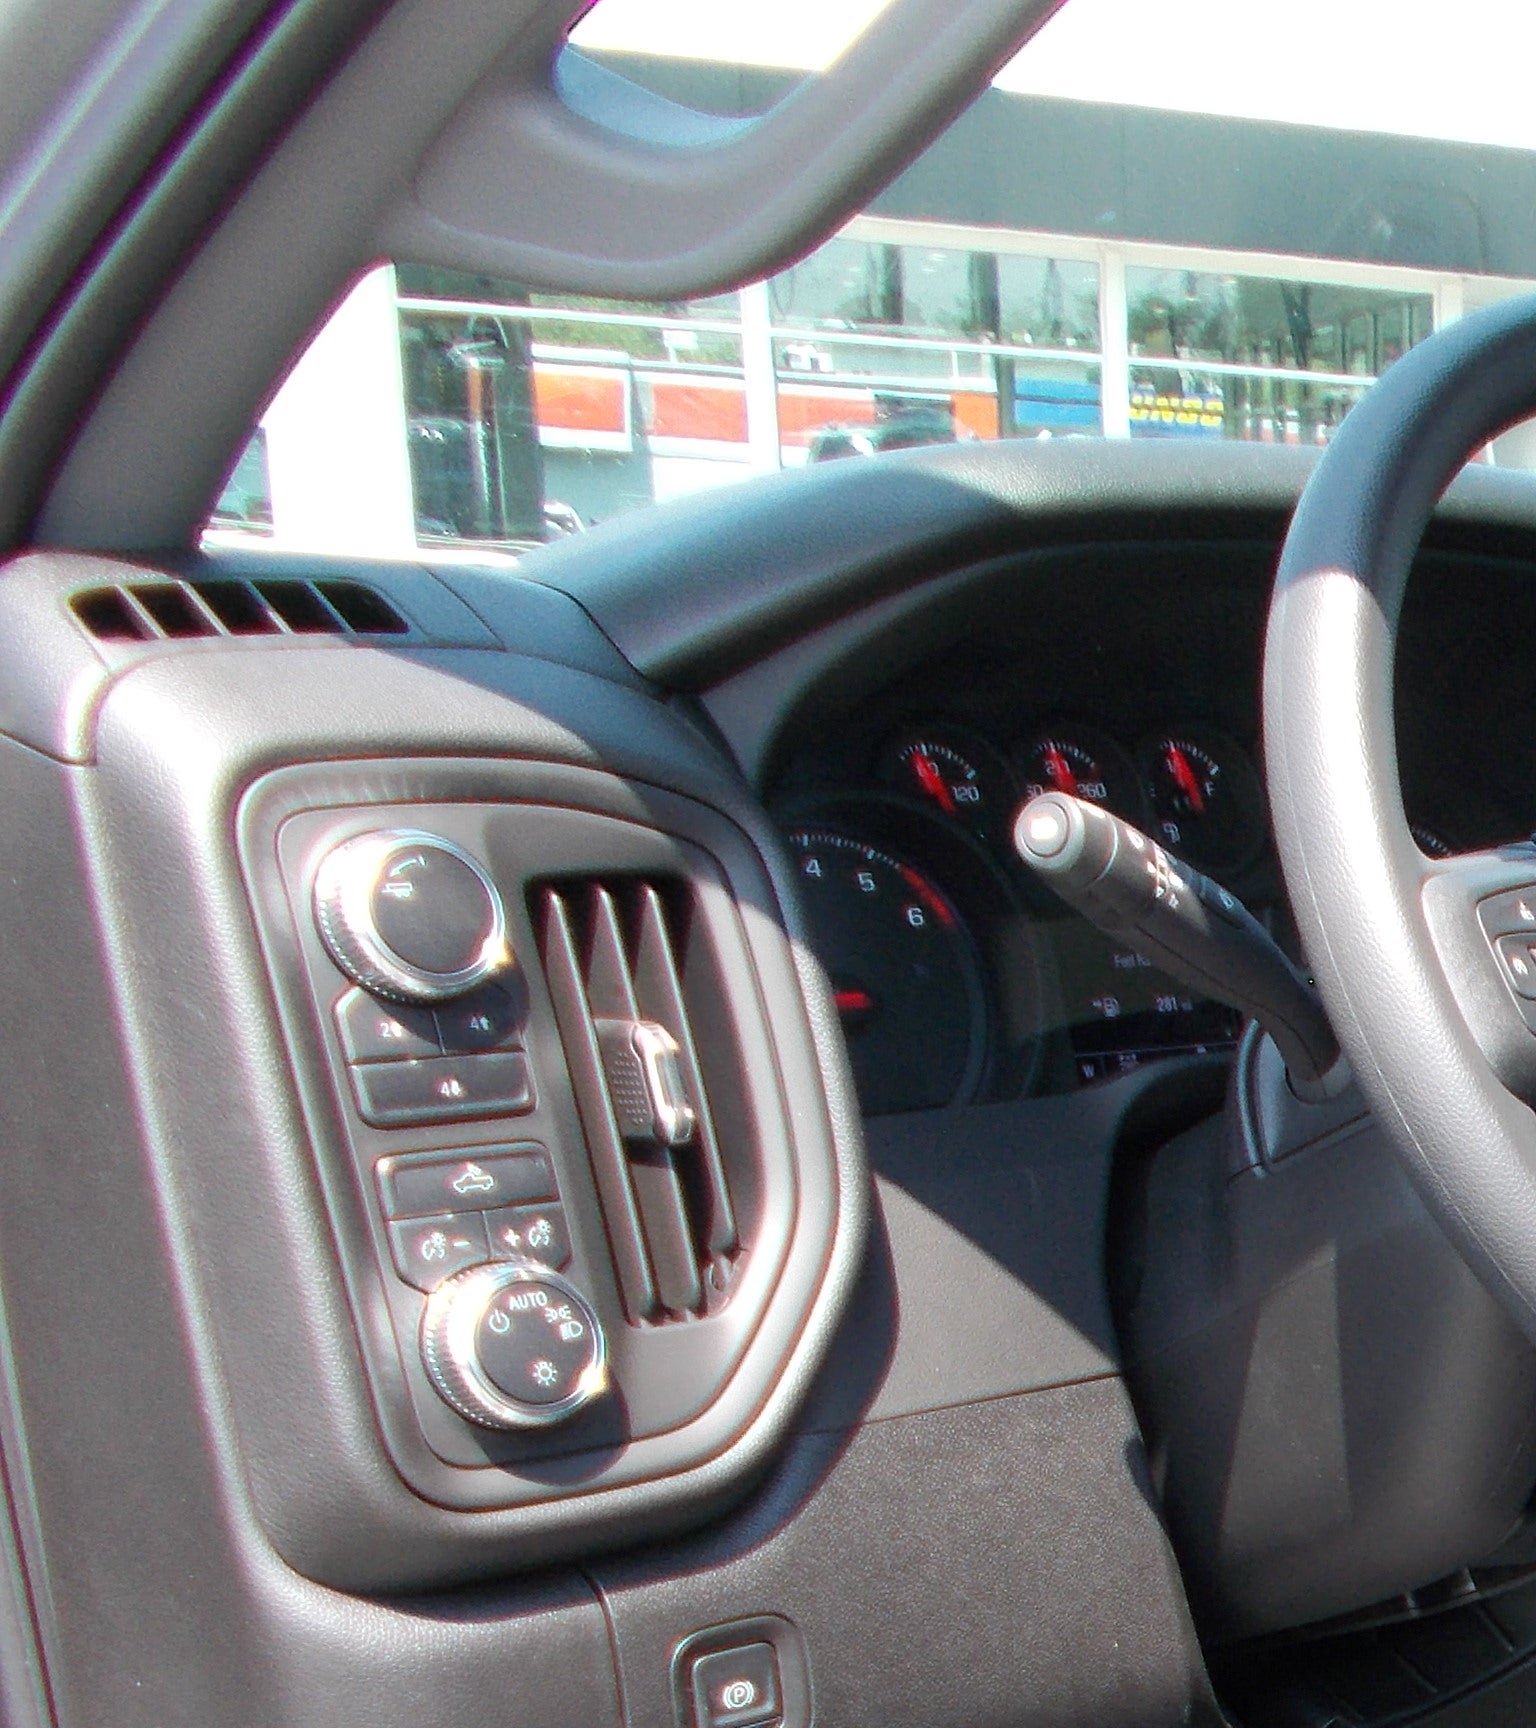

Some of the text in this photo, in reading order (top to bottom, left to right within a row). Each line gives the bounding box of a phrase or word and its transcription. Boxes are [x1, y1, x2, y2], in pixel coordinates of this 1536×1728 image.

[951, 785, 979, 802] 120
[806, 859, 821, 877] 4
[857, 872, 875, 892] 5
[907, 907, 925, 927] 6
[509, 1290, 548, 1310] AUTO
